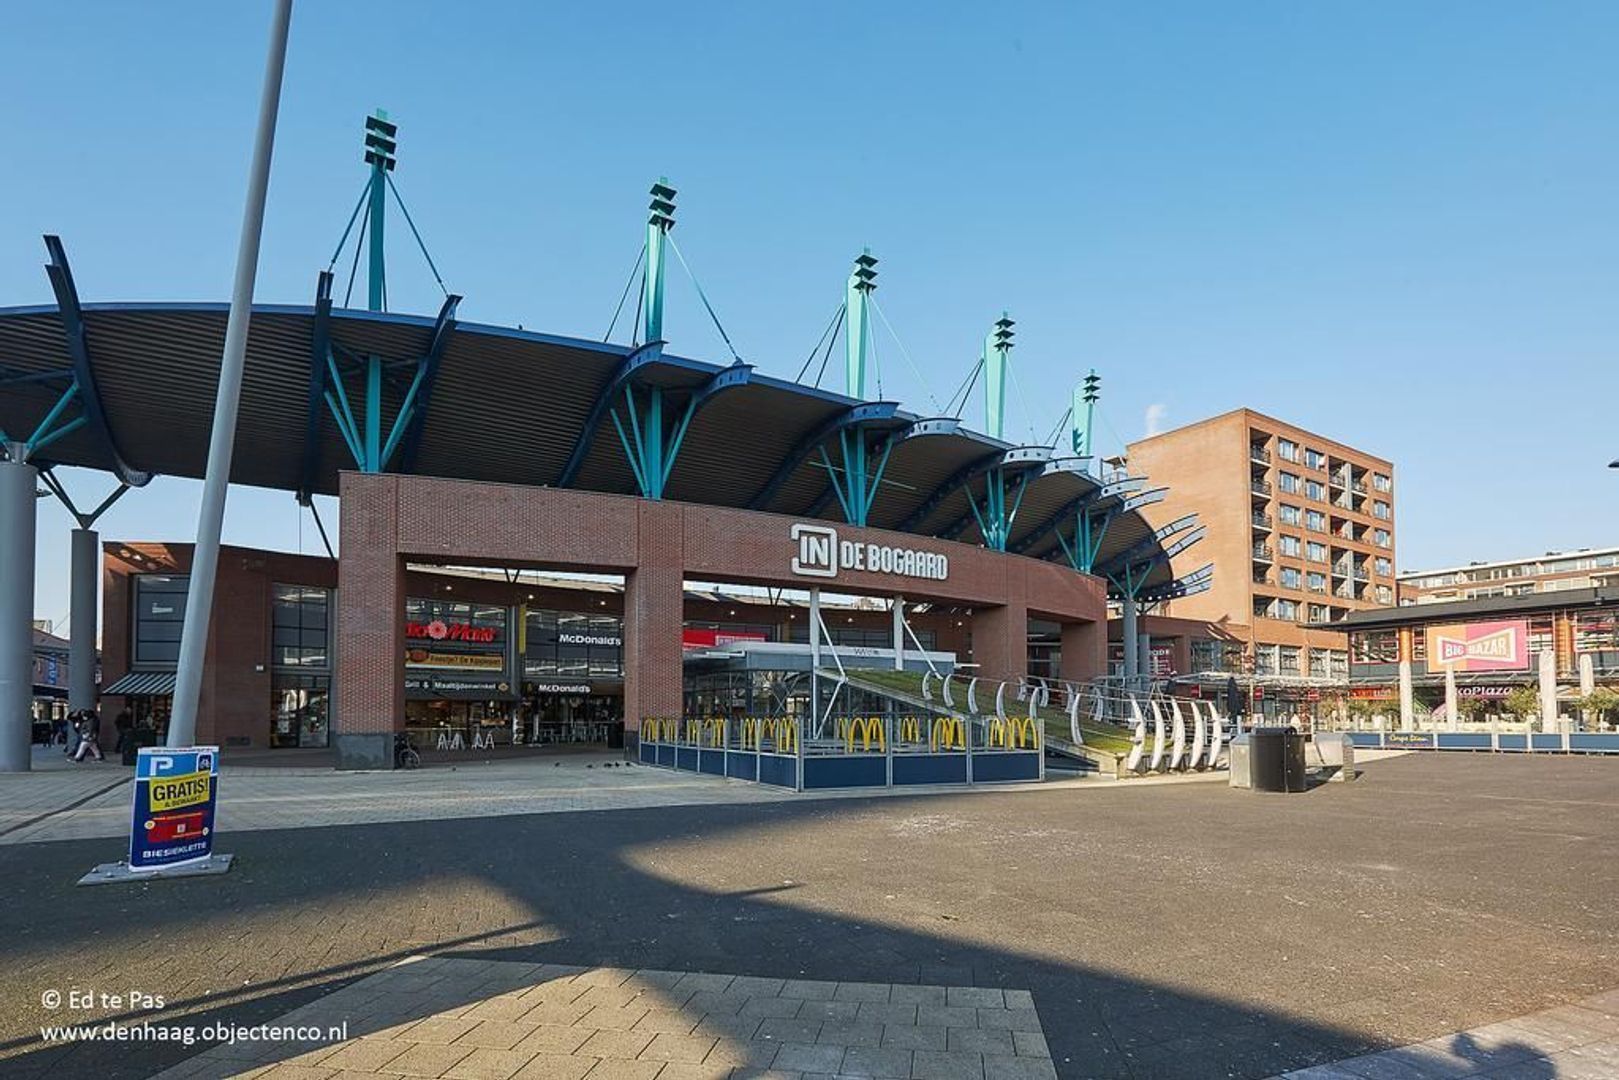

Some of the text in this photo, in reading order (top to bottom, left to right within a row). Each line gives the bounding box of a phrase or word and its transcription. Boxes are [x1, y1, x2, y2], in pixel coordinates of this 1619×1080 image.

[800, 536, 948, 580] IN DE BOGAARD
[559, 634, 621, 646] McDonald's
[1445, 643, 1465, 657] BIG
[538, 684, 591, 694] McDonald's
[150, 756, 174, 776] P
[153, 778, 209, 801] GRATIS!
